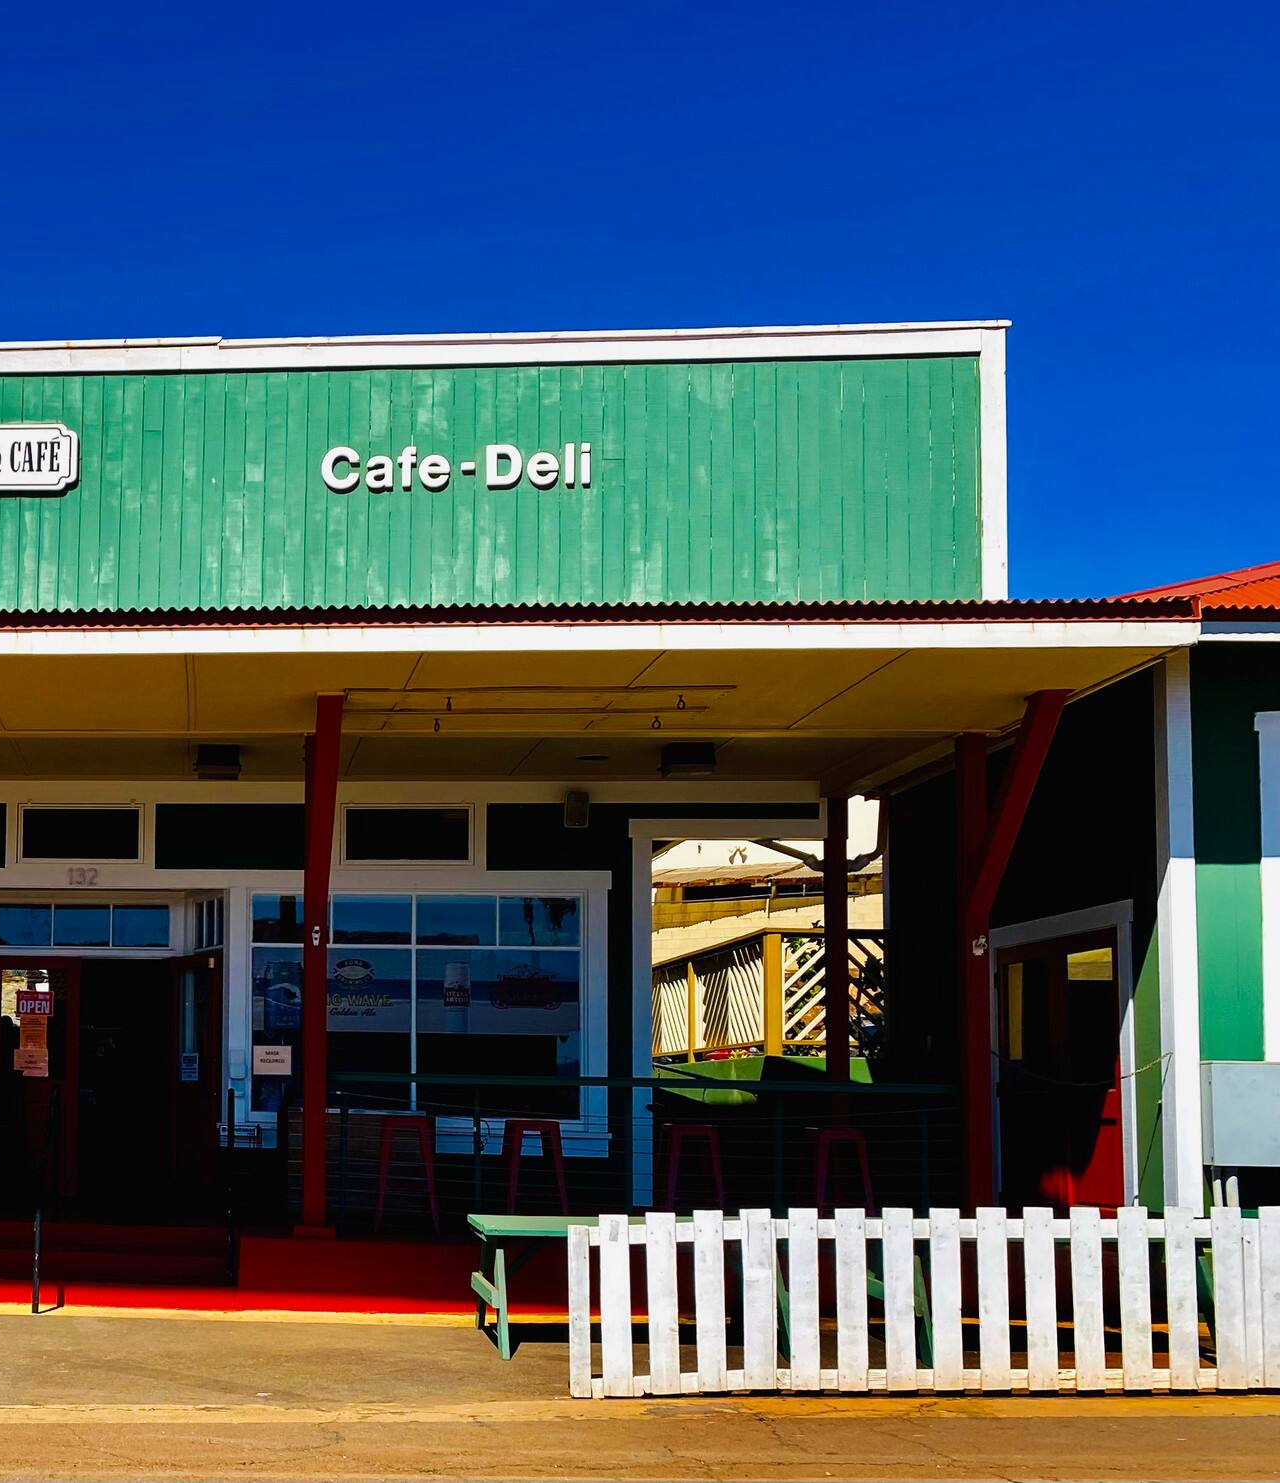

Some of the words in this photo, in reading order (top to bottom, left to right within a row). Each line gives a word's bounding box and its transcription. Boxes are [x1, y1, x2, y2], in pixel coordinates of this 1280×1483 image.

[9, 436, 61, 473] CAFÉ
[67, 867, 99, 887] 132
[20, 1000, 50, 1014] OPEN
[347, 993, 393, 1007] WAVE
